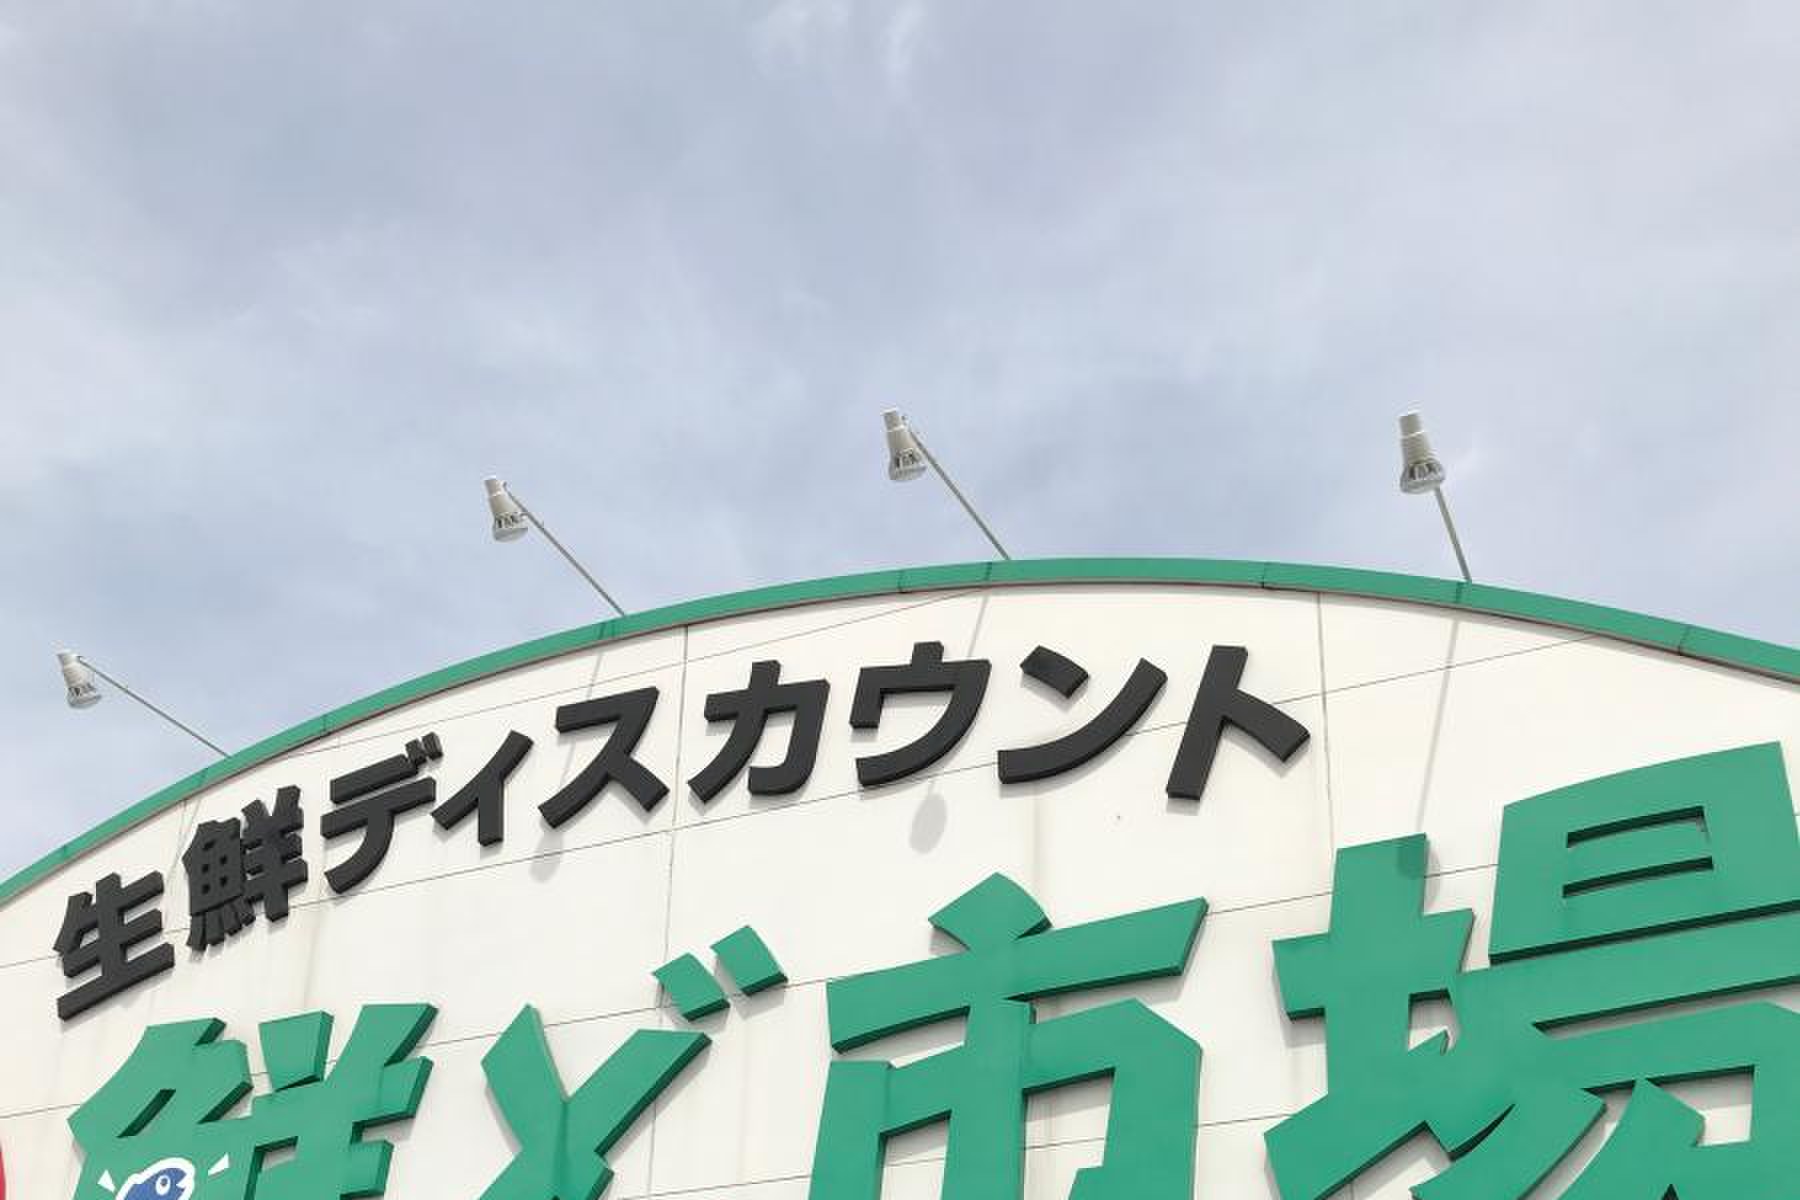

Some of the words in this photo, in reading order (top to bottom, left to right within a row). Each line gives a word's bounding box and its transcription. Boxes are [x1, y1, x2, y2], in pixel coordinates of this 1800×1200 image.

[54, 642, 1310, 1021] 生鮮ディスカウント
